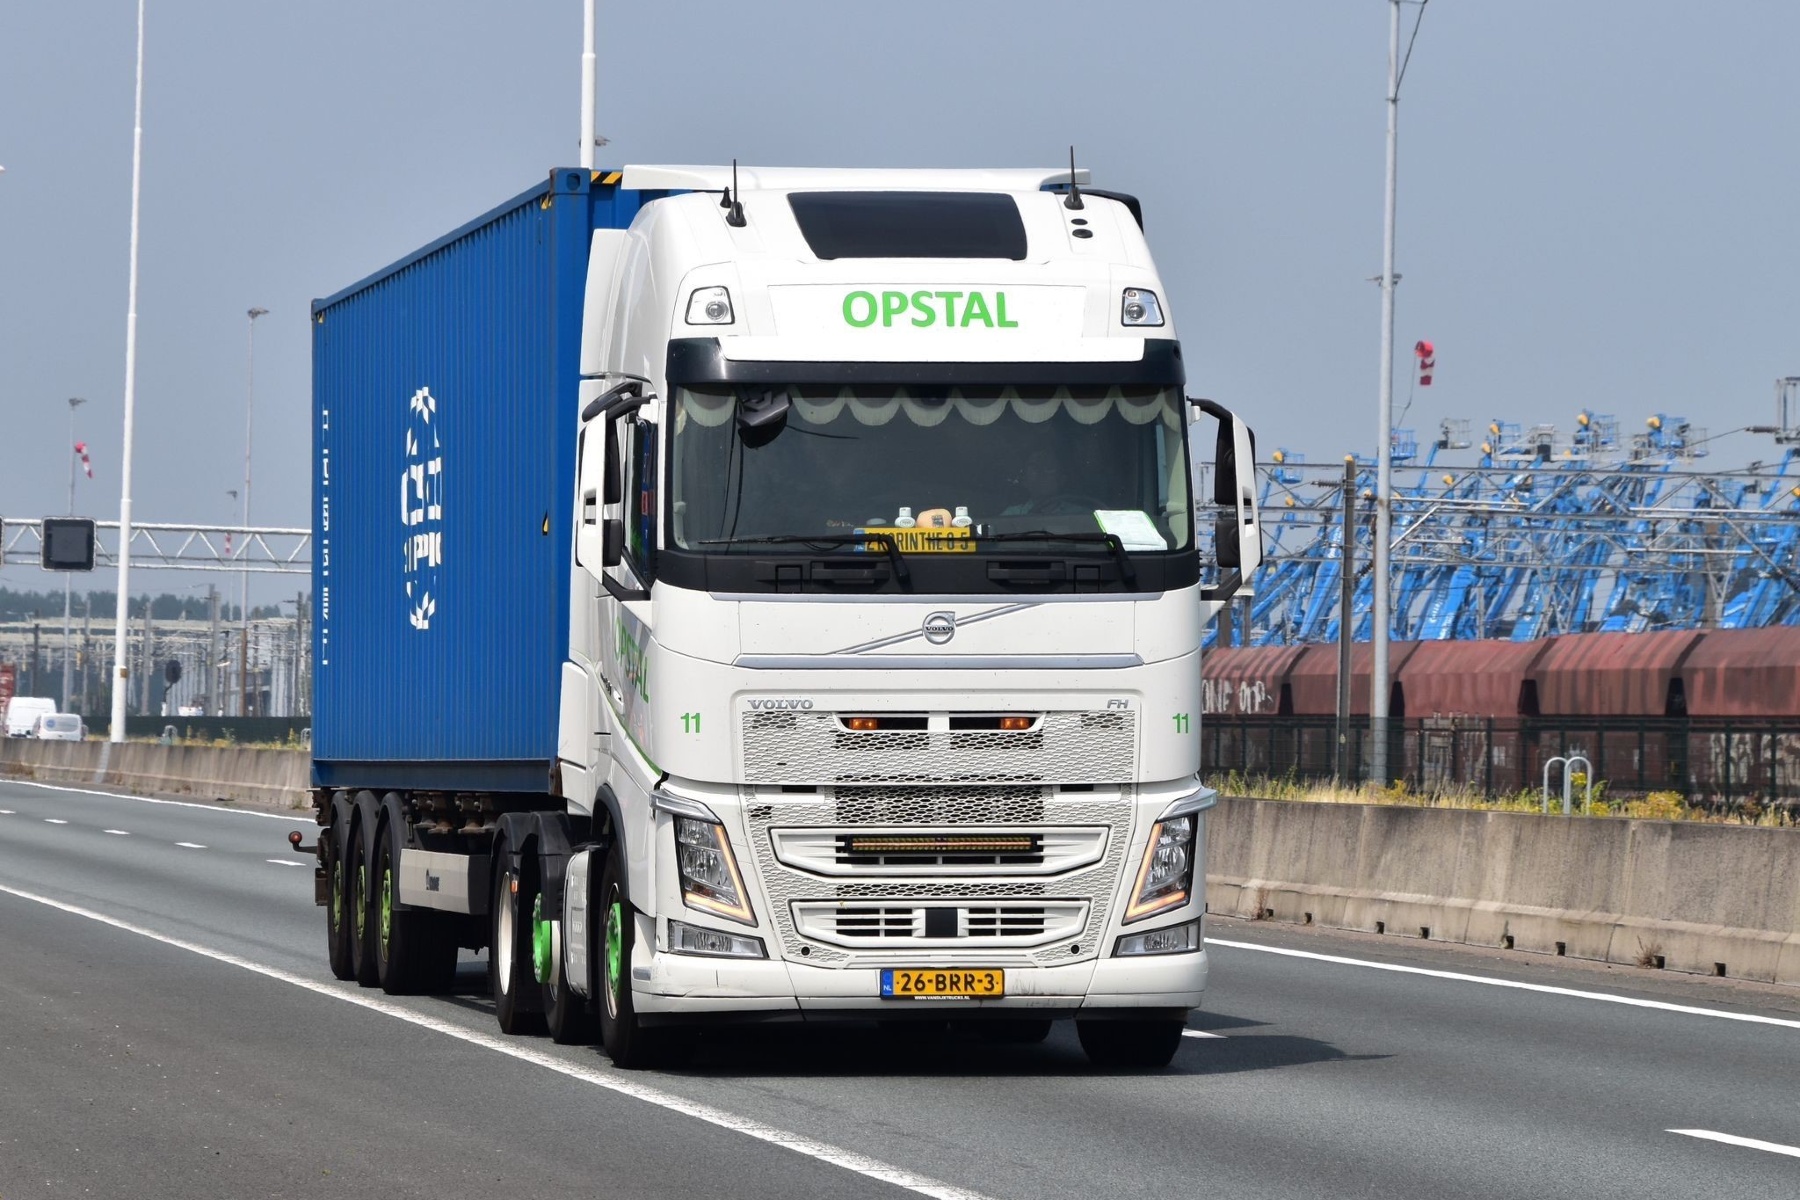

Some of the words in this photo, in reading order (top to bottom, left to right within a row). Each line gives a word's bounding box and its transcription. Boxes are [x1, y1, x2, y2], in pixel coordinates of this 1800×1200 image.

[842, 290, 1019, 328] OPSTAL
[614, 616, 649, 704] OPSTAL
[748, 699, 814, 710] VOLVO
[1106, 699, 1129, 709] FH
[680, 712, 701, 734] 11
[1172, 712, 1189, 734] 11
[900, 972, 996, 992] 26-BRR-3
